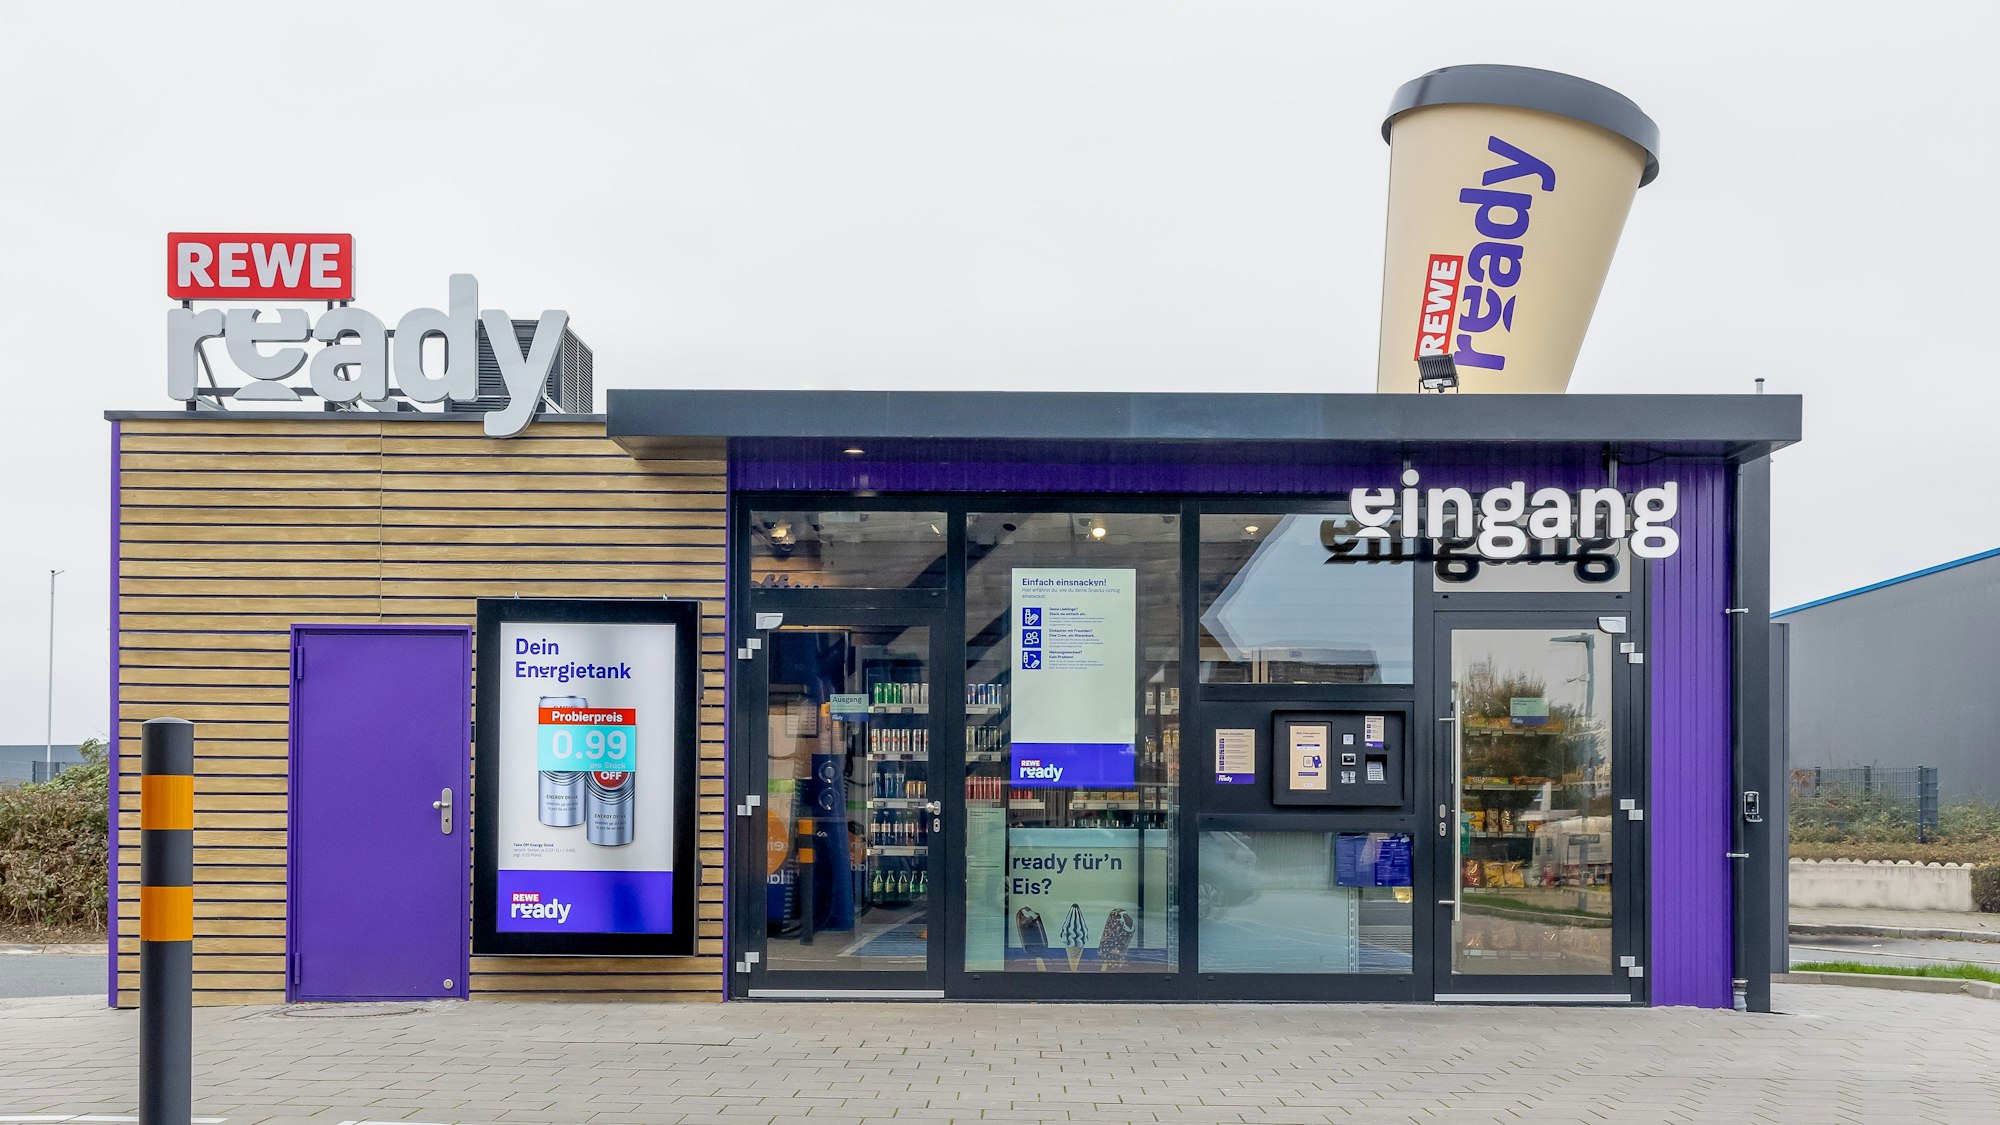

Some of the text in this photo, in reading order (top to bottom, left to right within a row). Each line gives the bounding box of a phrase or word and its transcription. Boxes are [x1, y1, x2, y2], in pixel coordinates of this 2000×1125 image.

[1453, 135, 1556, 371] ready
[177, 242, 343, 288] REWE
[1419, 260, 1459, 357] REWE
[167, 273, 569, 437] ready
[1350, 469, 1679, 559] eingang
[1022, 578, 1107, 587] Einfach einsnacken!
[515, 638, 559, 656] Dein
[515, 661, 631, 683] Energietank
[551, 710, 623, 724] Probierpreis
[552, 730, 627, 760] 0.99
[600, 772, 622, 780] OFF
[1020, 764, 1063, 782] ready
[1012, 853, 1067, 874] ready
[1013, 878, 1052, 895] Eis?
[512, 893, 540, 902] REWE
[511, 898, 571, 924] ready
